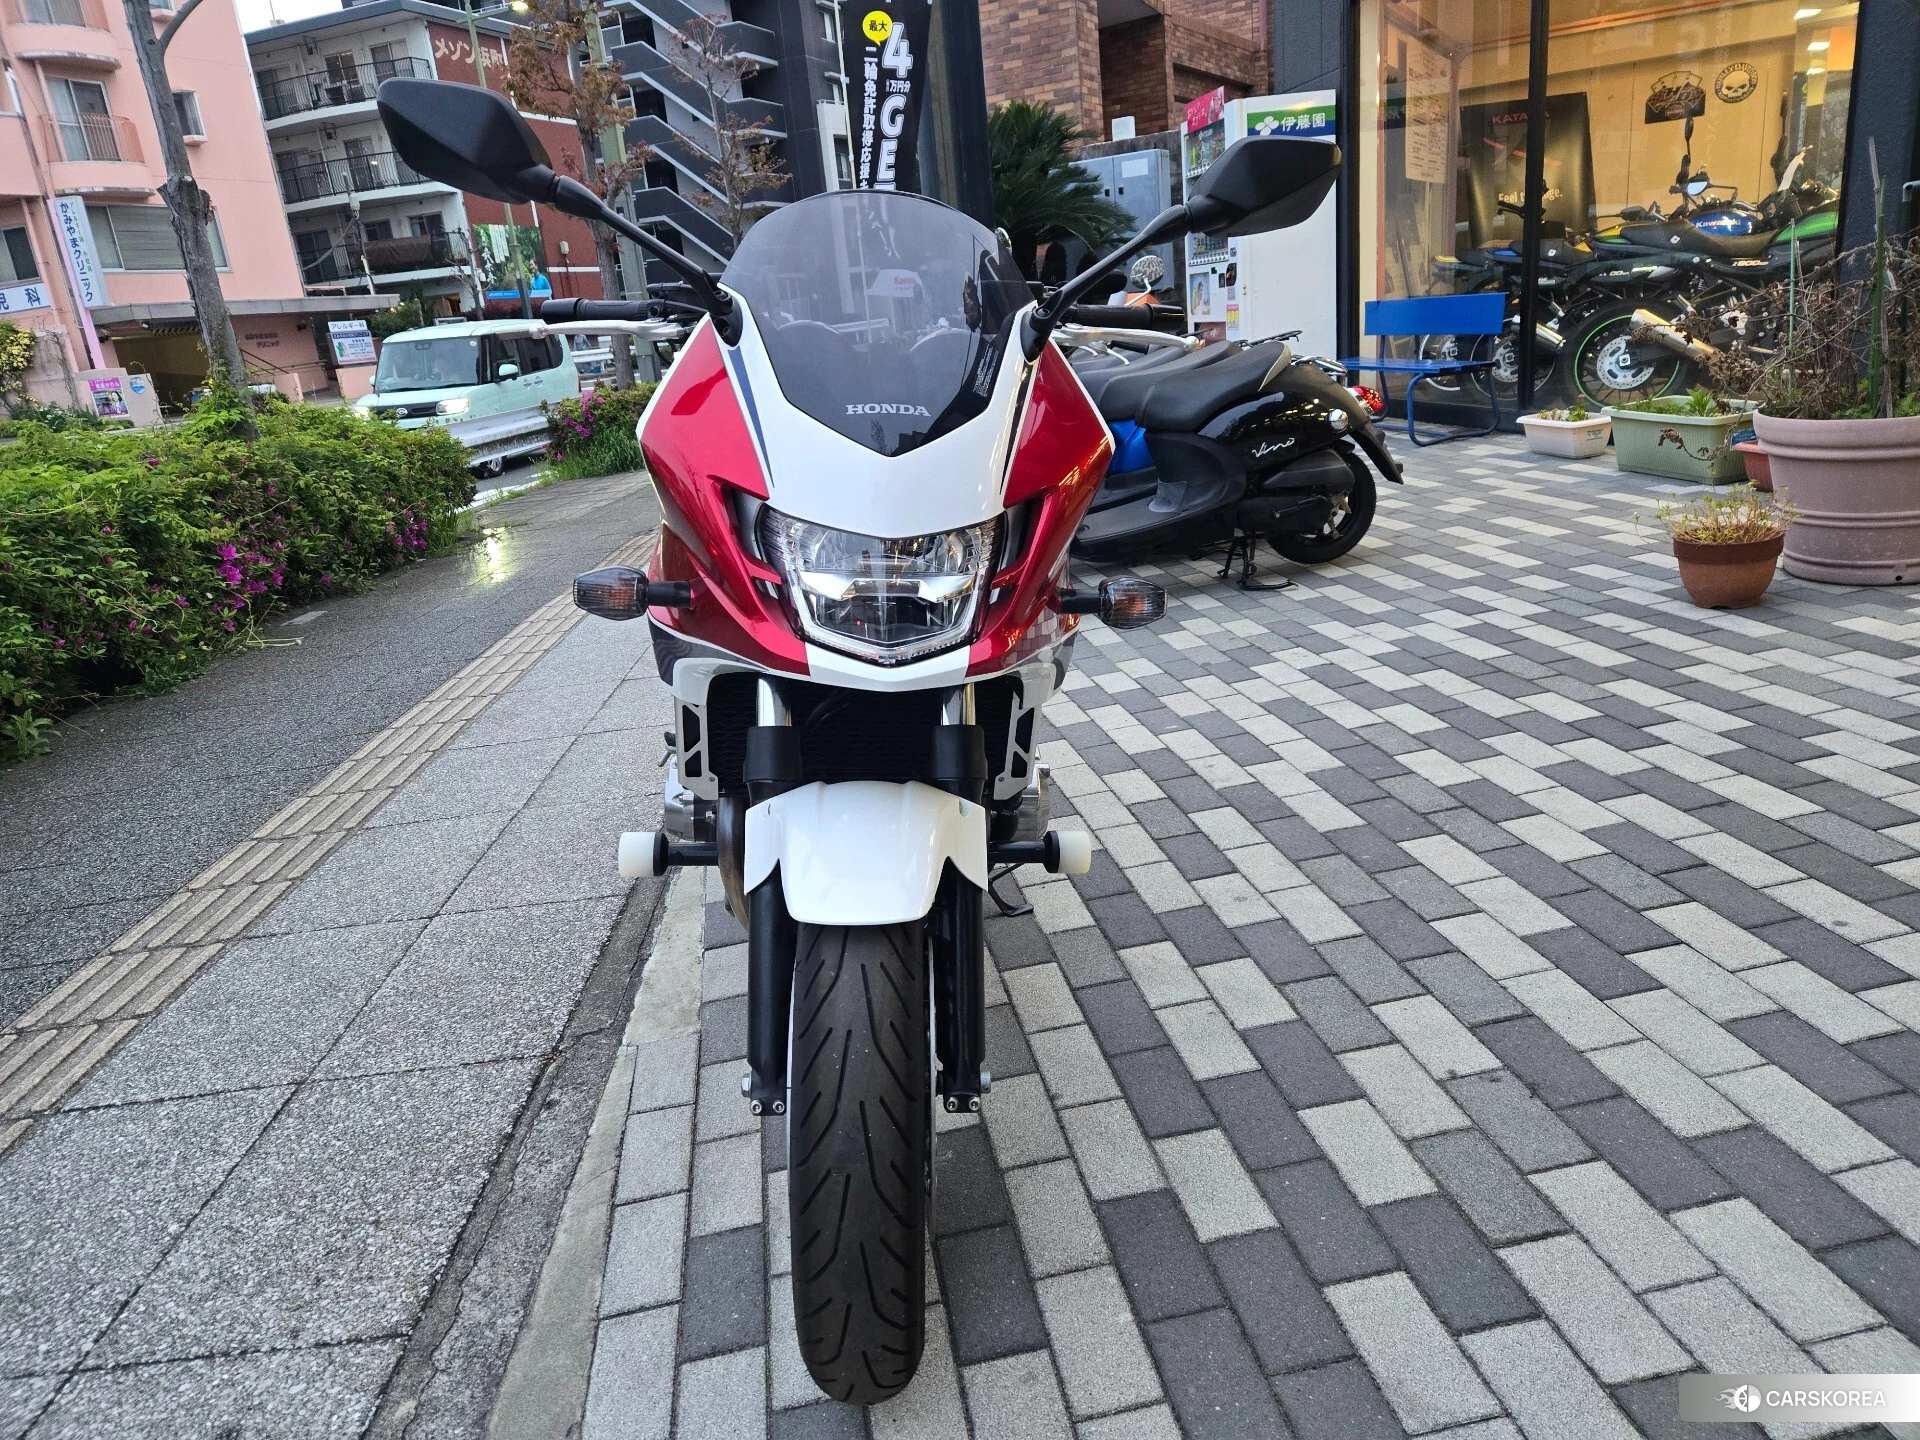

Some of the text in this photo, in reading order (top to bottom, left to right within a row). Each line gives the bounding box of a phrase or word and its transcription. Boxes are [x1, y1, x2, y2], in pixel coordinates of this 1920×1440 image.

[868, 20, 888, 32] 最大
[1280, 112, 1326, 133] 伊藤園
[60, 202, 94, 302] かみやまクリニック
[845, 403, 932, 417] HONDA
[1252, 437, 1295, 458] Vino
